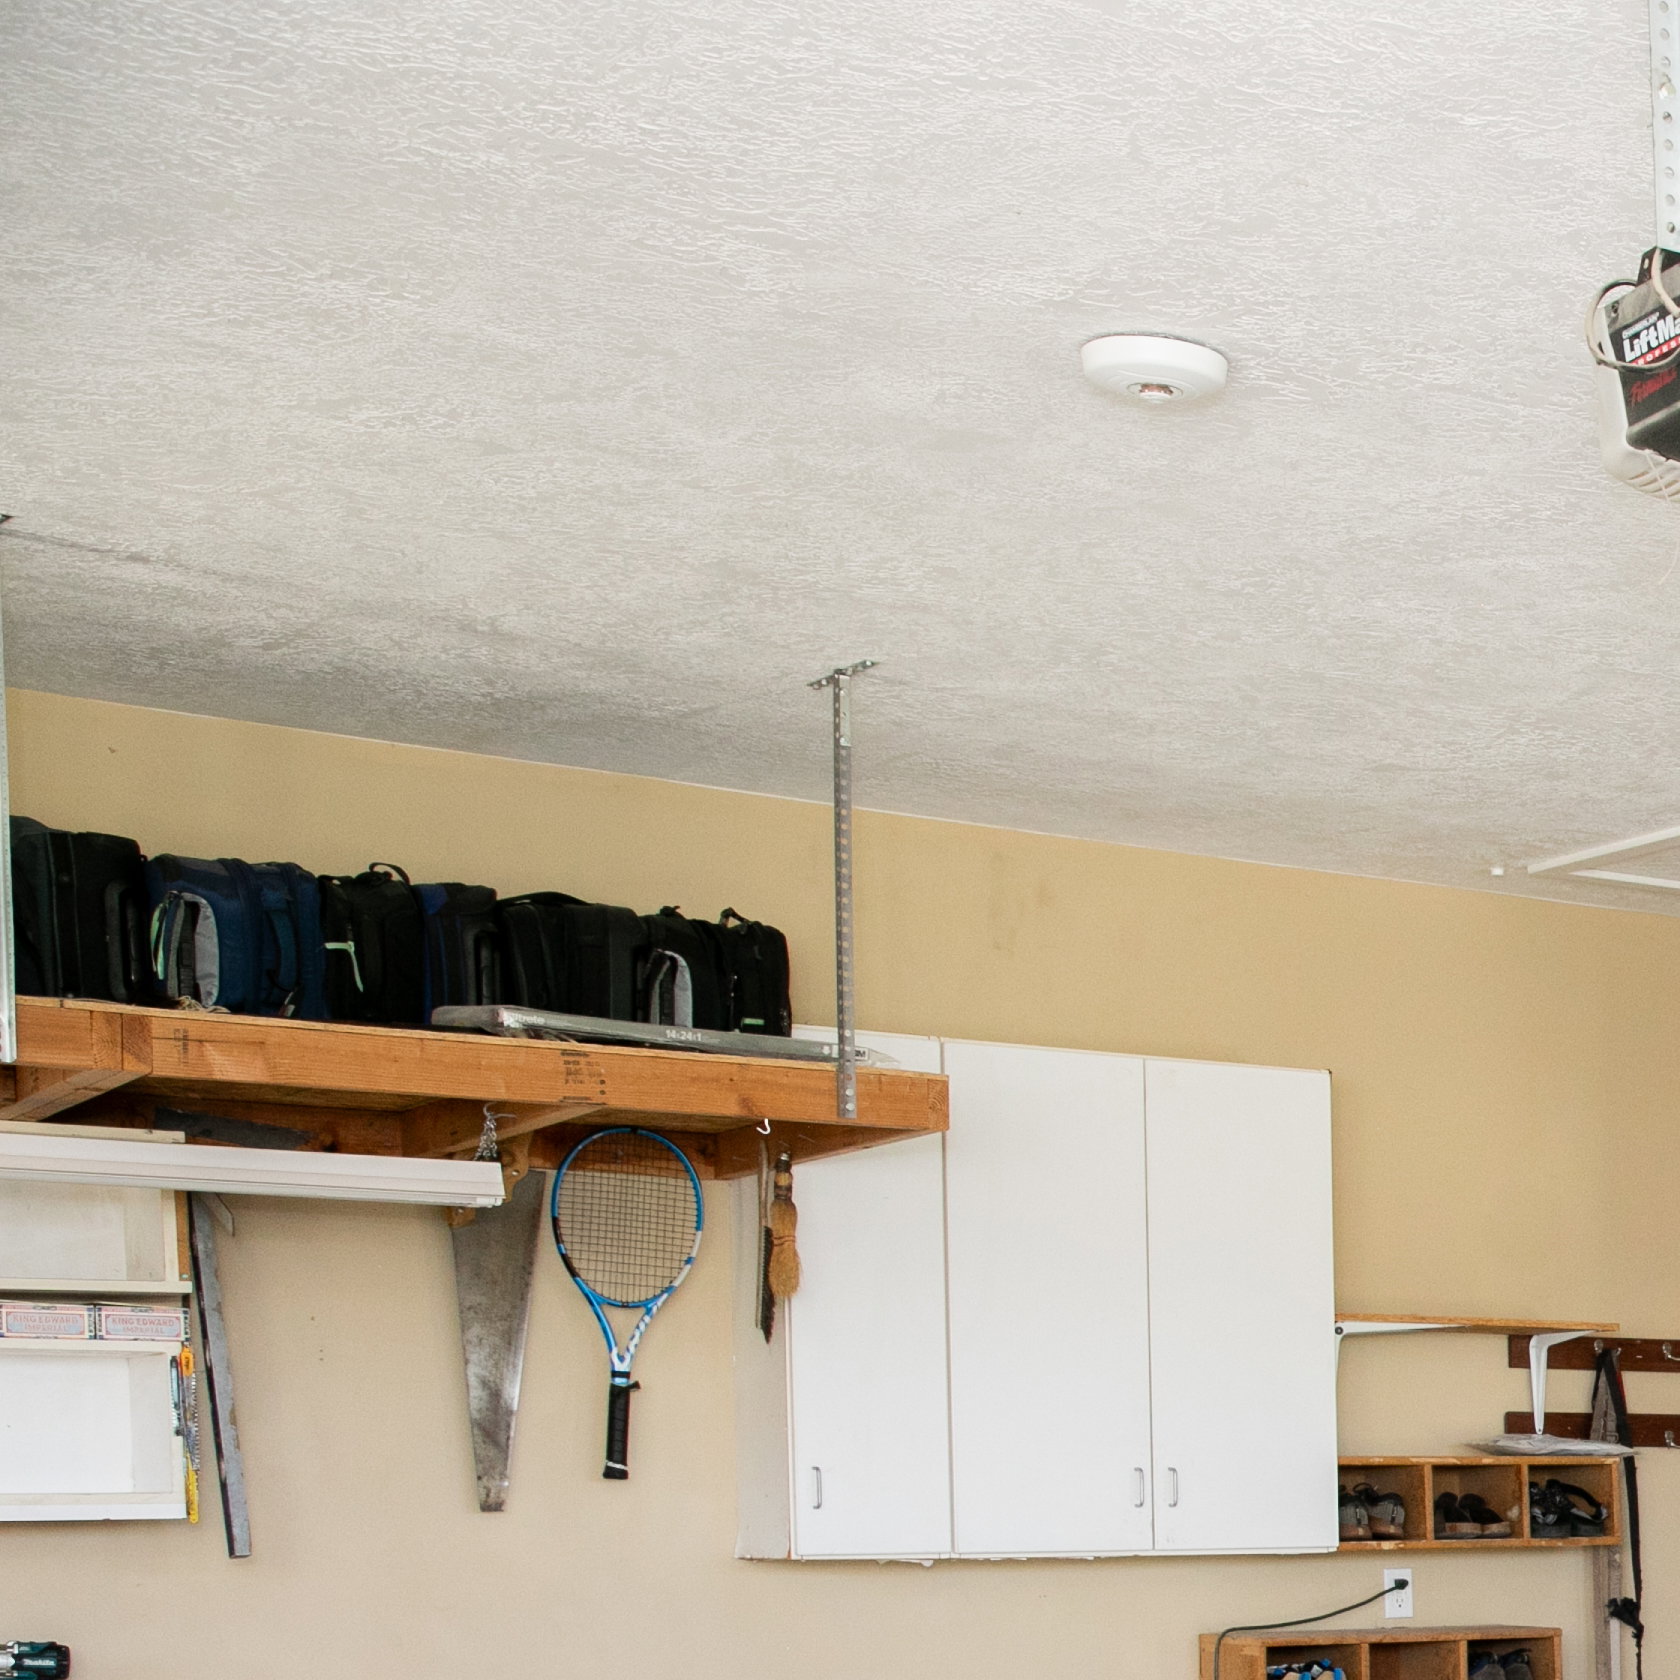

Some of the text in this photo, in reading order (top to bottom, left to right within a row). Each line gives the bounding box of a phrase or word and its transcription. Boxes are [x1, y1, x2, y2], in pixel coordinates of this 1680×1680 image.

[12, 1314, 78, 1325] KING EDWARD
[112, 1317, 174, 1327] KING EDWARD
